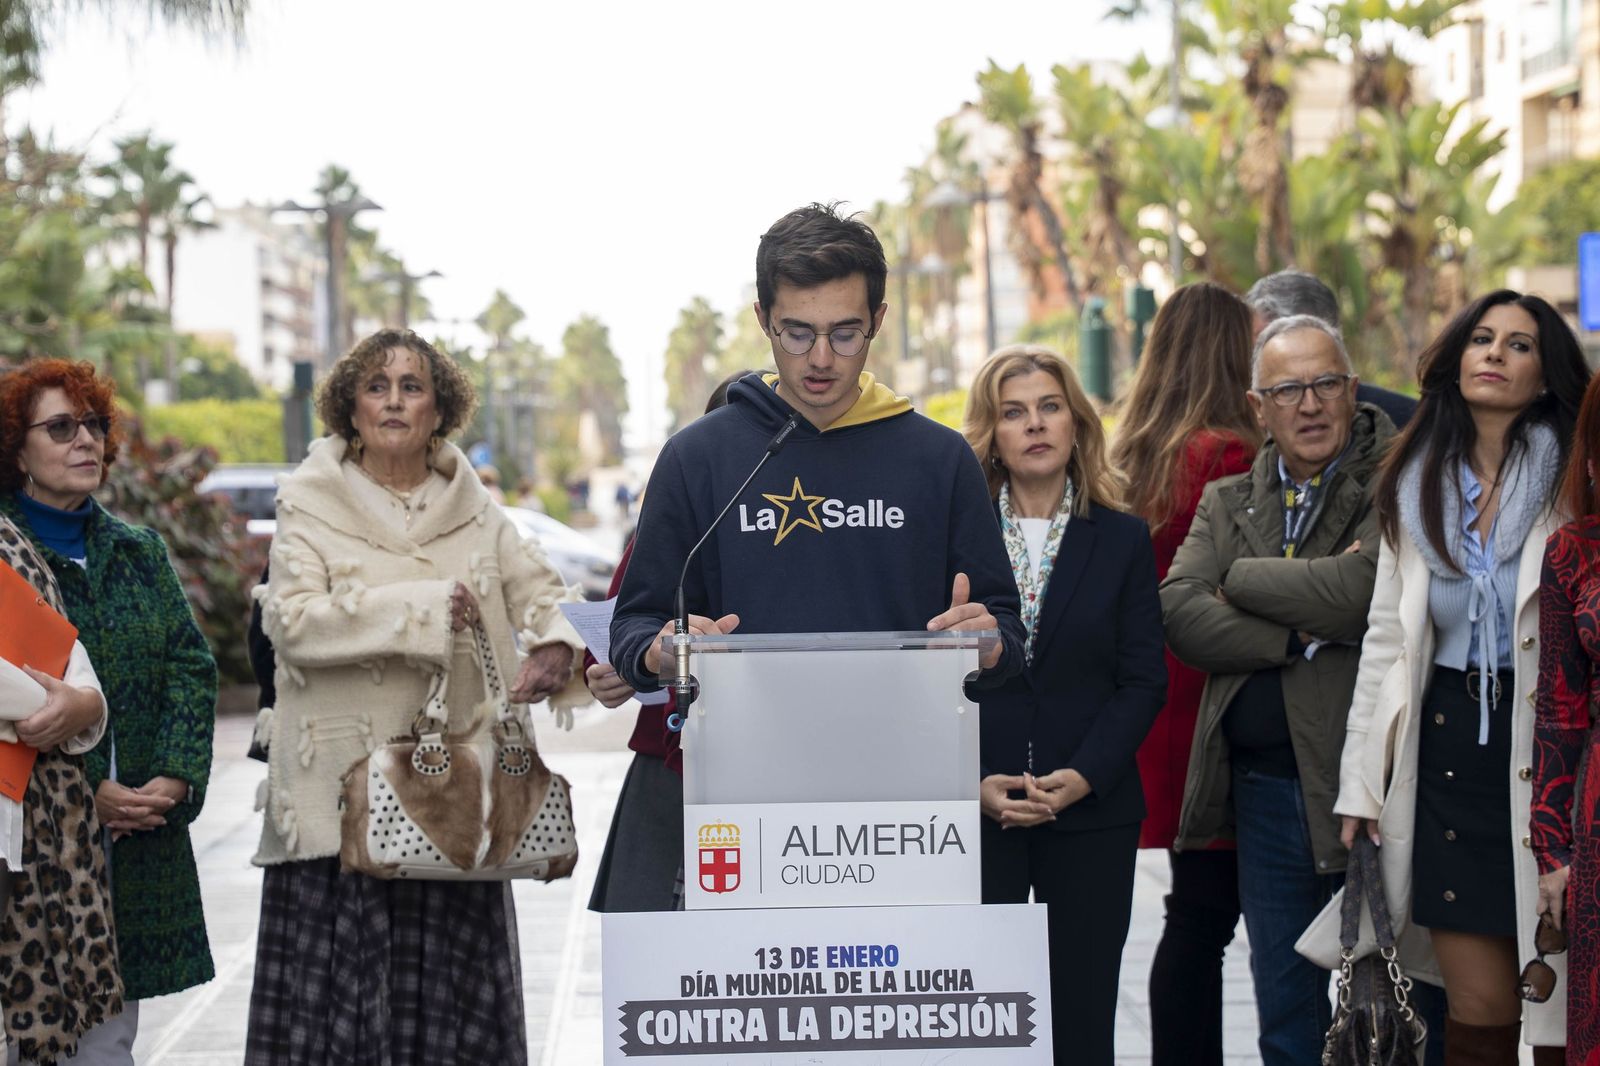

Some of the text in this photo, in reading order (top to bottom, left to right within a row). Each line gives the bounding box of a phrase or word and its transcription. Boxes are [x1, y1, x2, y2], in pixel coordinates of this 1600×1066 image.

[739, 498, 905, 532] La Salle
[781, 815, 967, 857] ALMERÍA
[780, 863, 875, 885] CIUDAD
[754, 944, 900, 970] 13 DE ENERO
[680, 968, 975, 998] DÍA MUNDIAL DE LA LUCHA
[636, 996, 1019, 1045] CONTRA LA DEPRESIÓN
